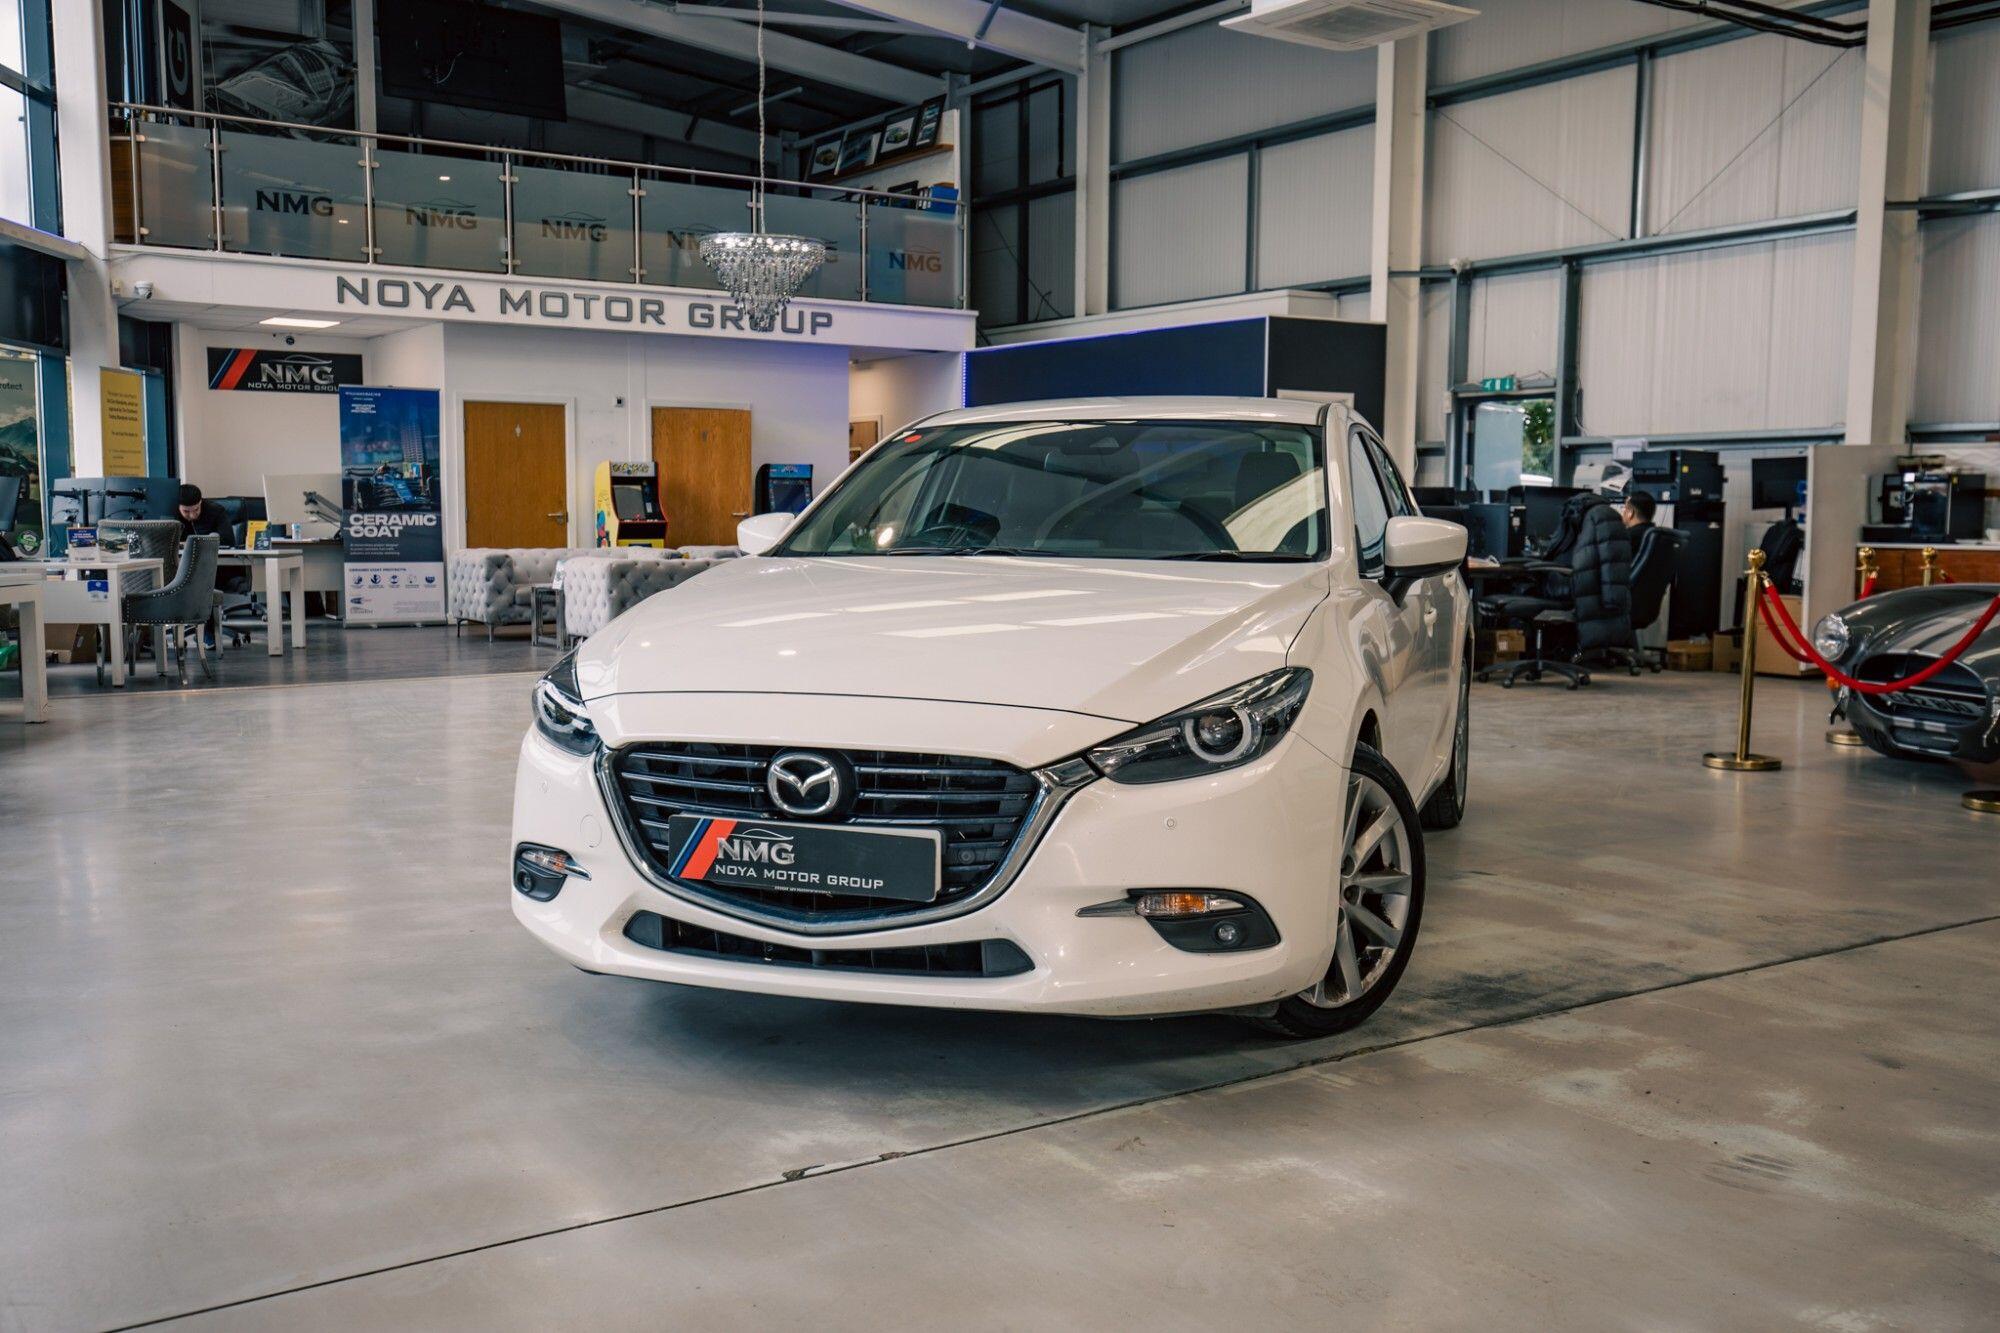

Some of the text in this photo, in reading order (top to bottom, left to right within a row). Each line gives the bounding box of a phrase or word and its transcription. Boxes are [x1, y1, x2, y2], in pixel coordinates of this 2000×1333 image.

[256, 190, 333, 217] NMG
[406, 206, 478, 230] NMG
[542, 219, 608, 242] NMG
[667, 231, 702, 250] NM
[888, 251, 942, 273] NMG
[336, 275, 476, 313] NOYA
[499, 287, 666, 325] MOTOR
[260, 362, 335, 385] NMG
[277, 383, 311, 391] MOTOR
[349, 513, 437, 527] CERAMIC
[350, 526, 403, 538] COAT
[716, 836, 795, 866] NMG
[715, 864, 884, 890] NOYA MOTOR GROUP
